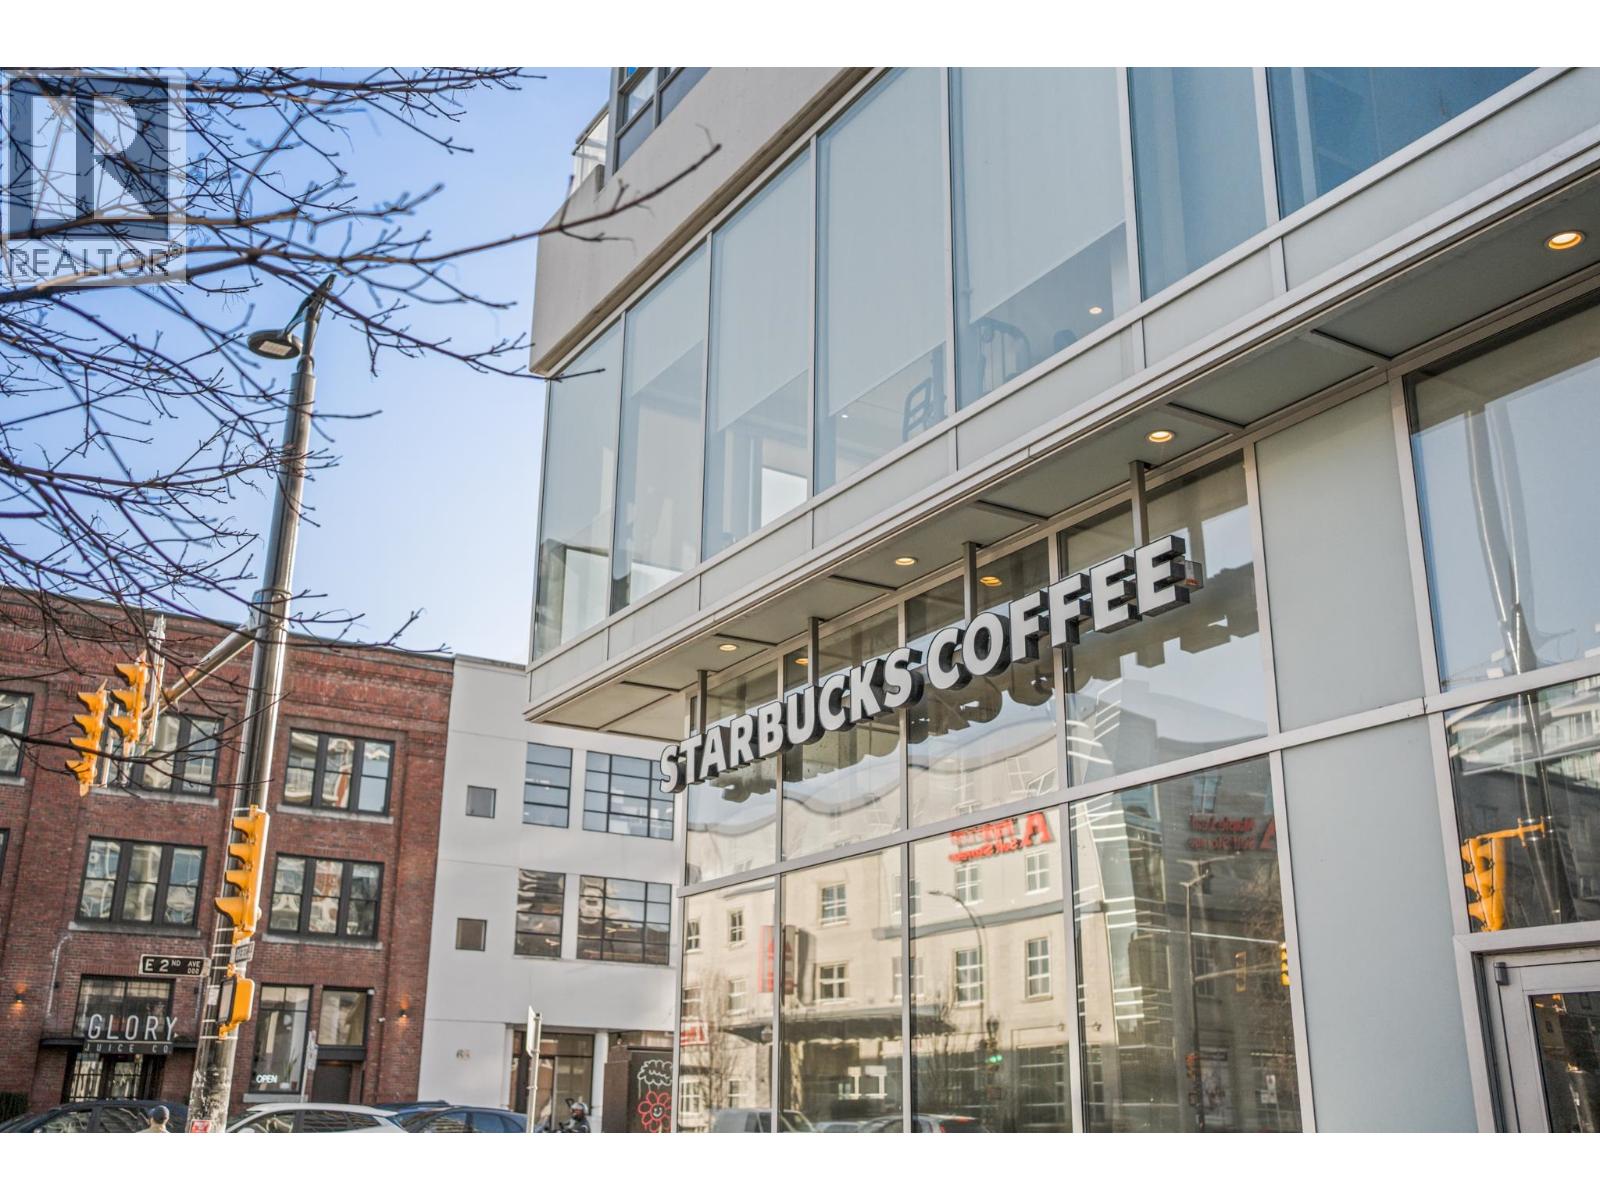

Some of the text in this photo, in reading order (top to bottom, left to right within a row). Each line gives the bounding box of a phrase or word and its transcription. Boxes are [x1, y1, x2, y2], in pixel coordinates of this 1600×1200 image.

[659, 534, 1190, 794] STARBUCKS COFFEE
[145, 959, 154, 972] E
[88, 1013, 178, 1041] GLORY
[85, 1043, 135, 1053] JUICE
[256, 1074, 278, 1084] OPEN
